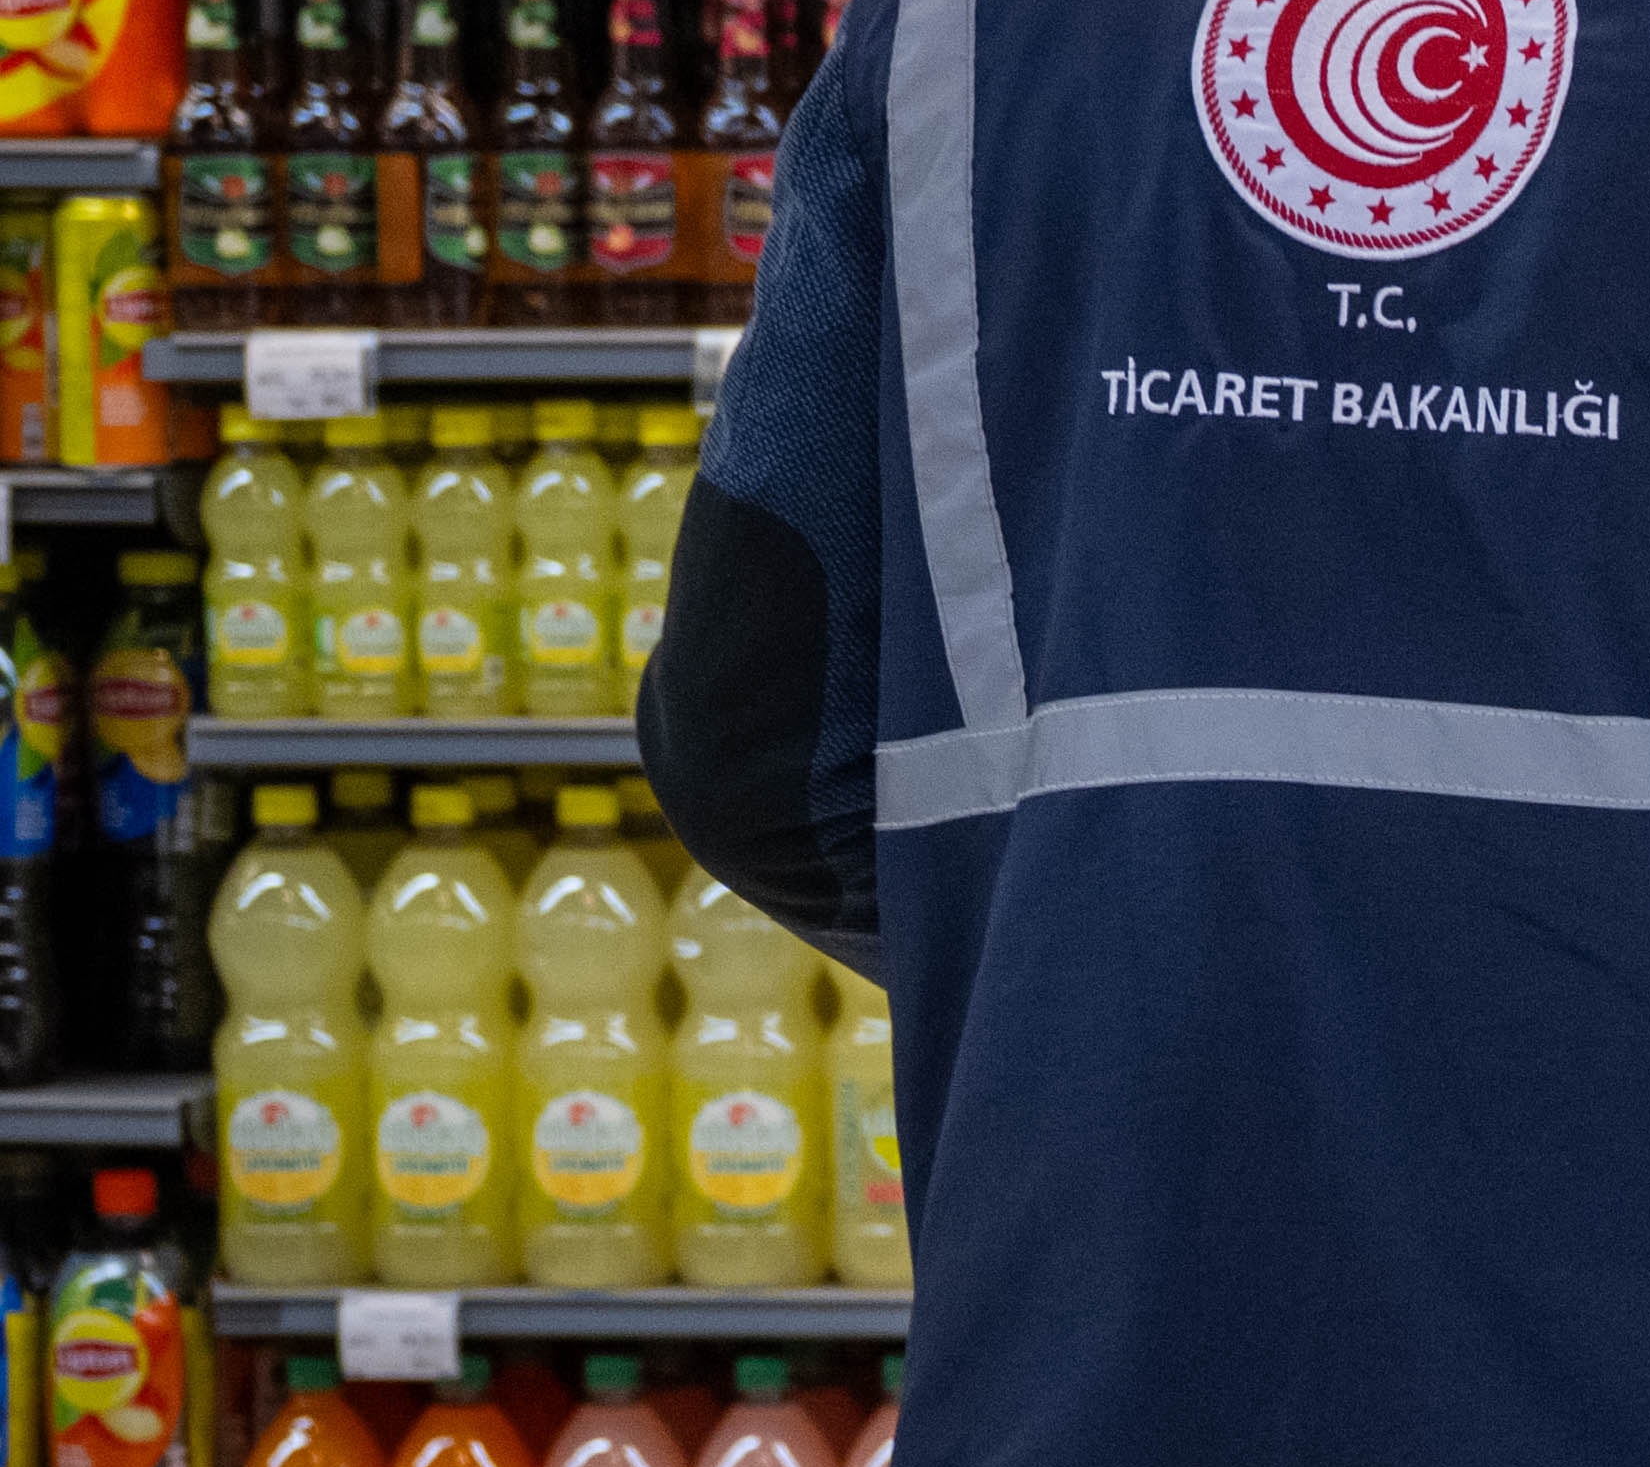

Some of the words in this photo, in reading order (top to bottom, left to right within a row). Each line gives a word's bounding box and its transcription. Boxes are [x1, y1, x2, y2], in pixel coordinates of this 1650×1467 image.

[1327, 284, 1417, 332] T.C.
[1101, 356, 1318, 423] TİCARET
[1332, 380, 1619, 440] BAKANLIĞI
